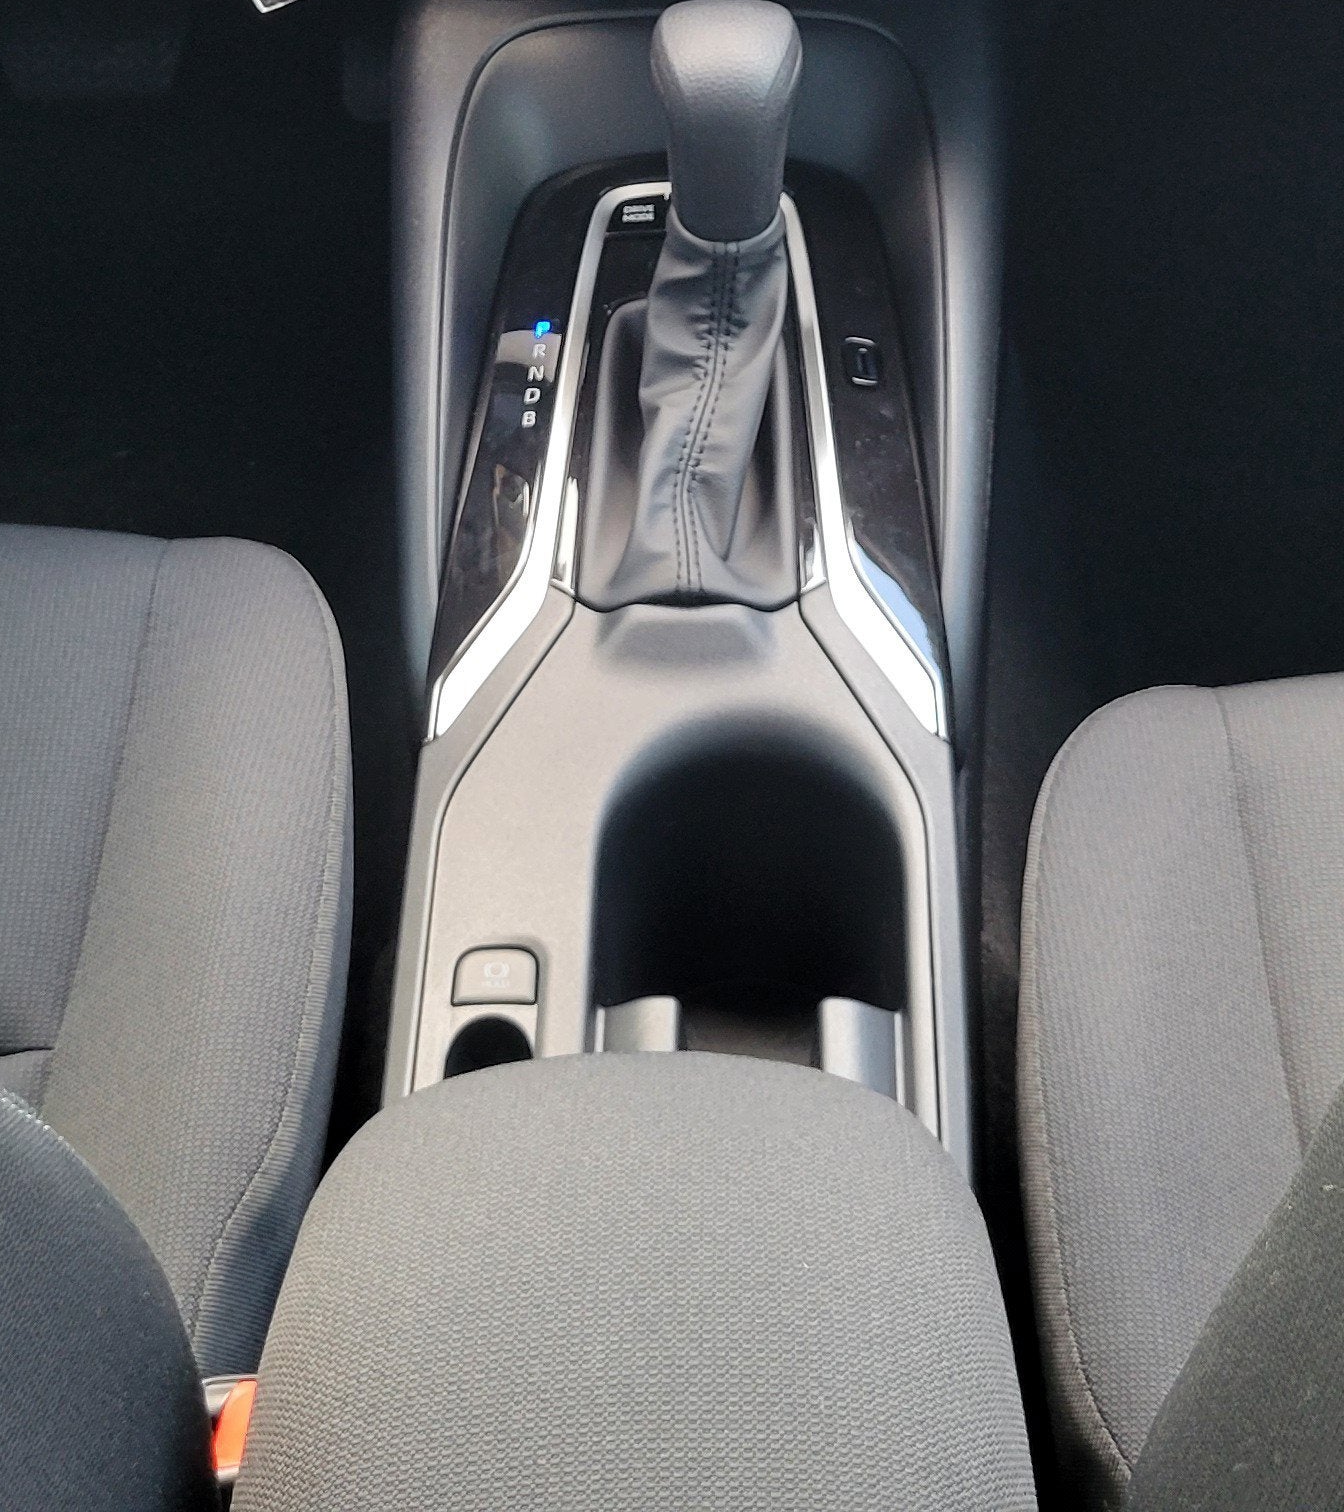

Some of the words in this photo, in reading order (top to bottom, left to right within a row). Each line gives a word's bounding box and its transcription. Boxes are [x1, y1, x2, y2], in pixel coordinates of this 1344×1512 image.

[535, 321, 551, 339] P
[532, 343, 547, 359] R
[527, 365, 544, 382] N
[523, 387, 541, 405] D
[521, 410, 537, 428] B
